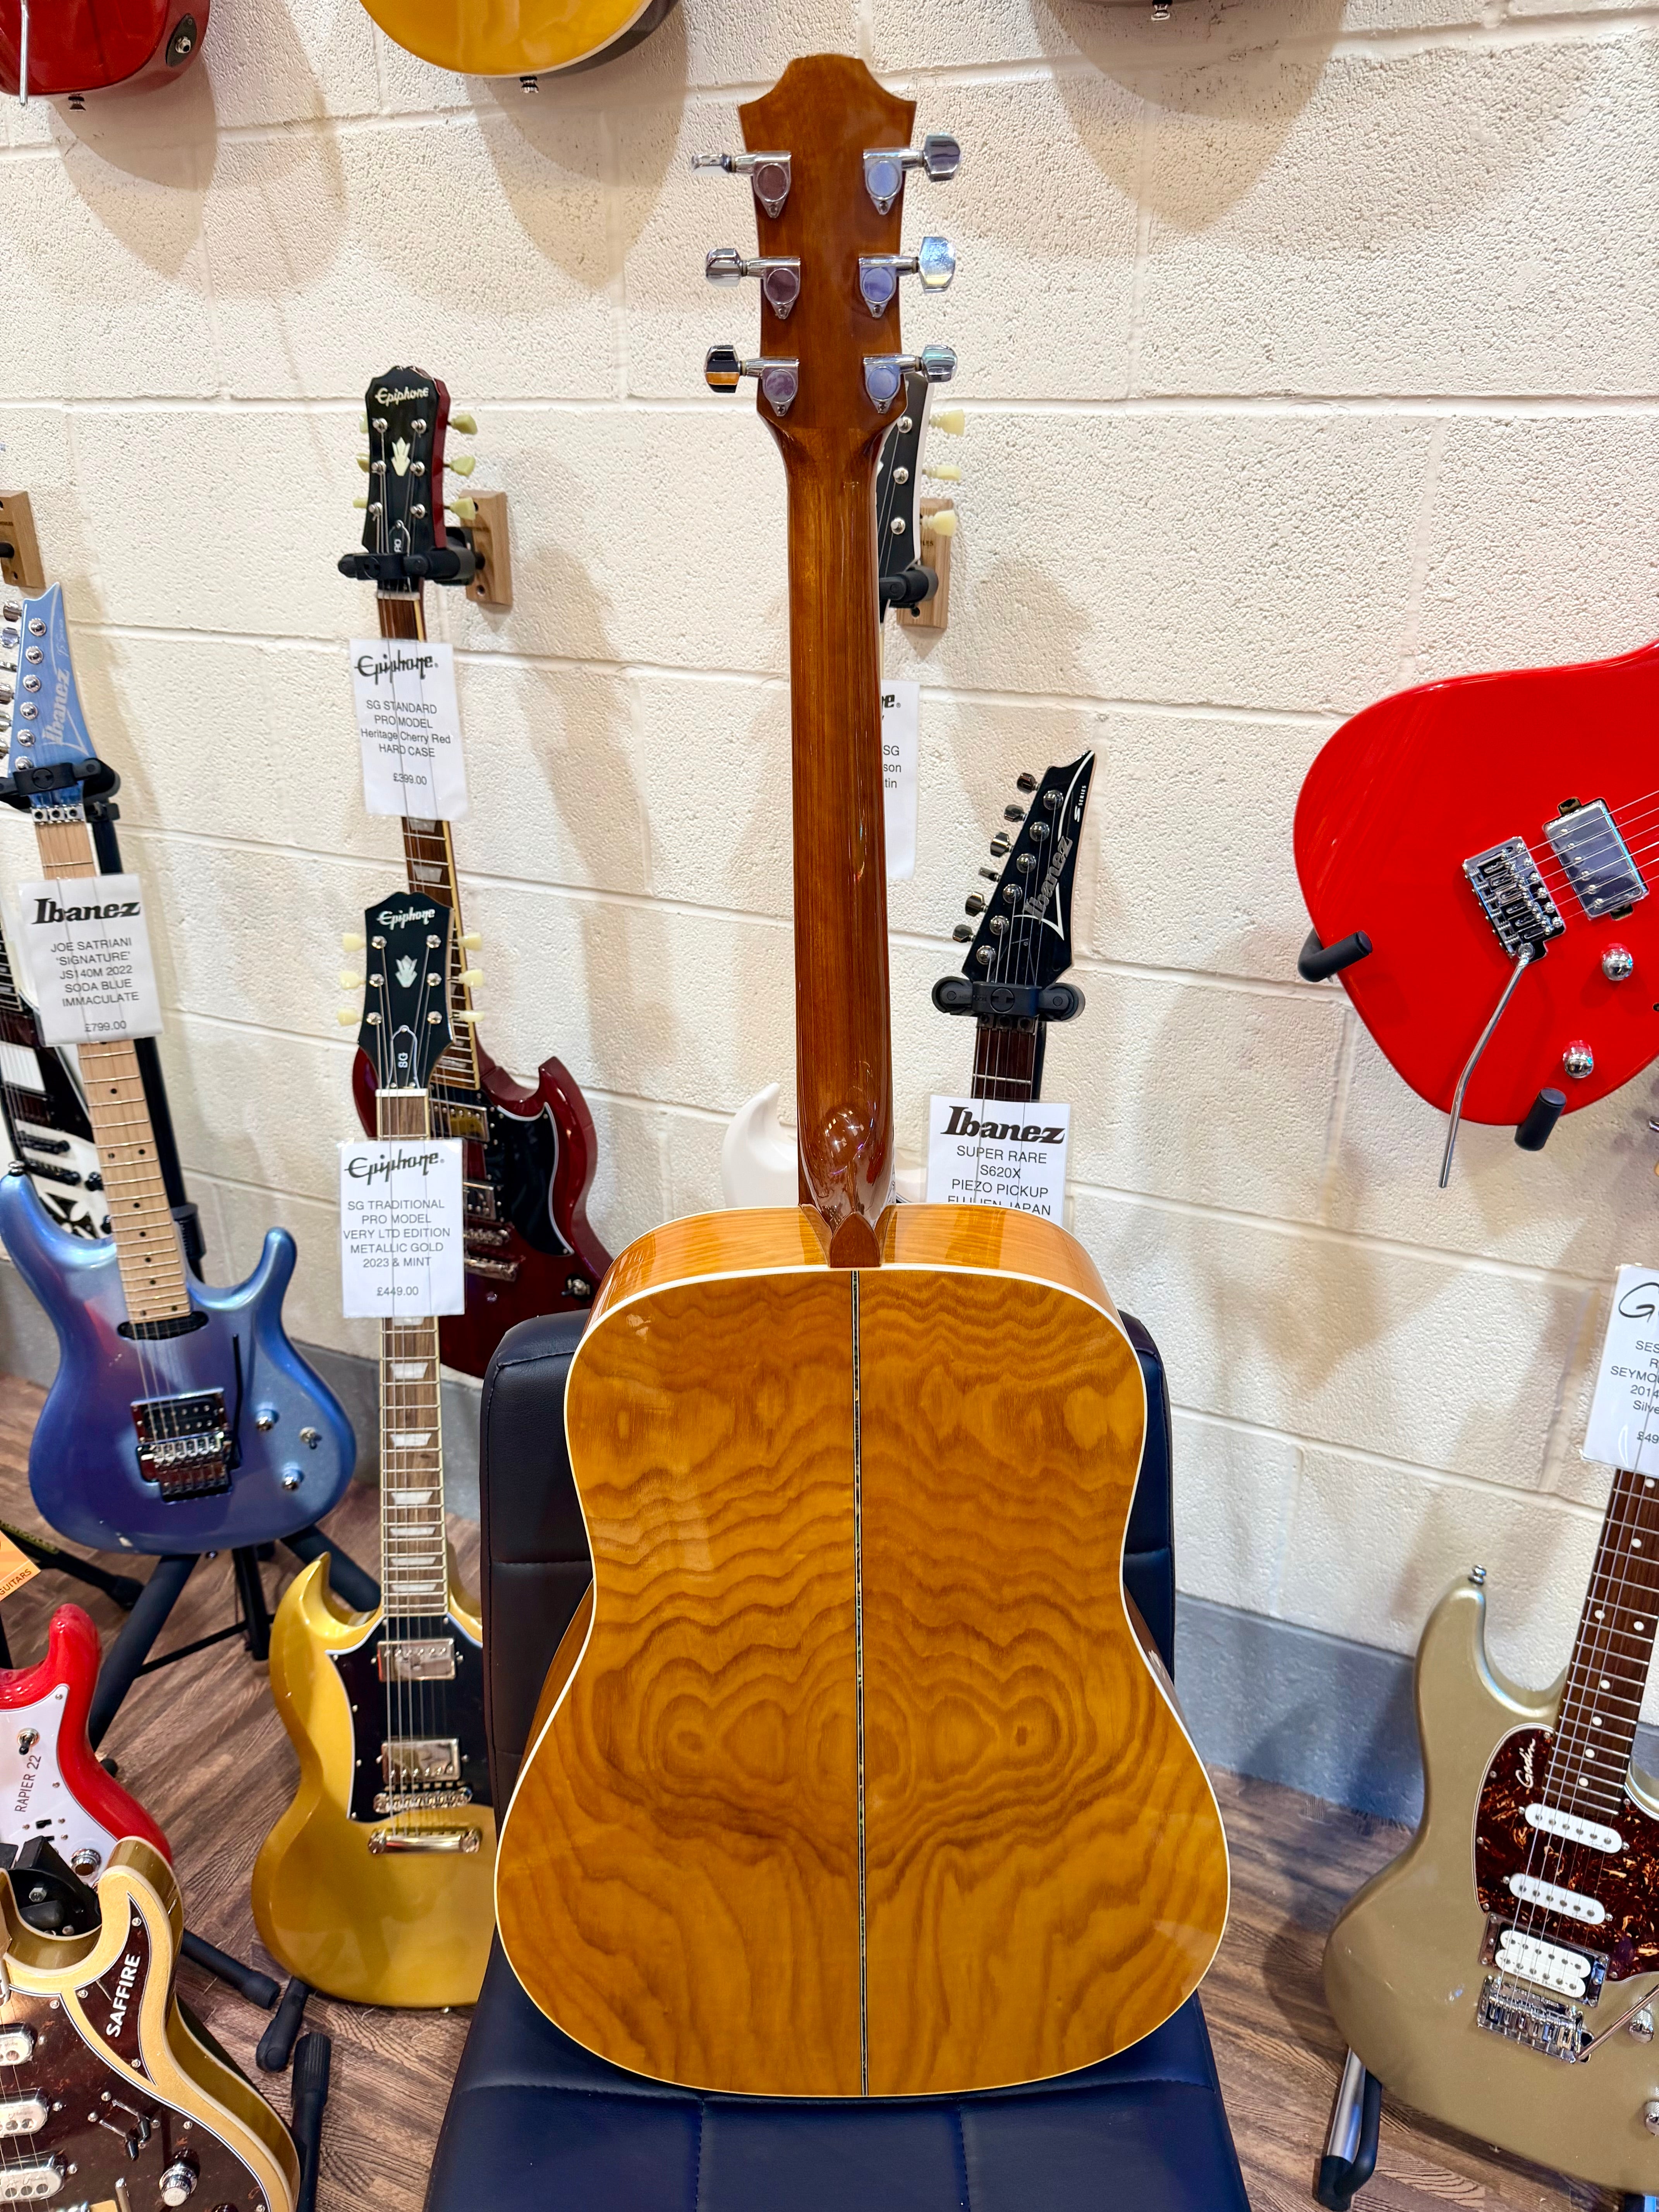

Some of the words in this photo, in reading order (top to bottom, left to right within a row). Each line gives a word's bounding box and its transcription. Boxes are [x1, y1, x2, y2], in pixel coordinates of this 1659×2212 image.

[375, 386, 429, 406] Epiphone
[354, 649, 433, 685] Epiphone
[42, 669, 70, 745] Ibanez
[366, 700, 381, 710] SG
[383, 701, 437, 714] STANDARD
[374, 715, 396, 725] PRO
[398, 717, 433, 728] MODEL
[361, 728, 398, 741] Heritage
[400, 732, 429, 745] Cherry
[432, 734, 451, 744] Red
[379, 744, 406, 755] HARD
[408, 746, 435, 757] CASE
[883, 745, 899, 756] SG
[393, 773, 427, 785] £399.00
[1078, 785, 1086, 806] SERIES
[1022, 836, 1073, 925] Ibanez
[31, 897, 141, 925] Ibanez
[376, 907, 435, 930] Epiphone
[51, 942, 74, 952] JOE
[77, 938, 132, 950] SATRIANI
[60, 968, 103, 979] JS140M
[106, 965, 132, 975] 2022
[65, 982, 98, 993] SODA
[102, 979, 132, 990] BLUE
[62, 992, 139, 1006] IMMACULATE
[85, 1021, 126, 1032] £799.00
[398, 1053, 408, 1068] SG
[940, 1106, 1065, 1144] Ibanez
[957, 1146, 1003, 1161] SUPER
[1008, 1151, 1047, 1163] RARE
[344, 1149, 438, 1185] Epiphone
[980, 1164, 1021, 1179] S620X
[952, 1179, 992, 1193] PIEZO
[997, 1184, 1048, 1198] PICKUP
[348, 1201, 364, 1210] SG
[368, 1199, 445, 1210] TRADITIONAL
[362, 1215, 387, 1224] PRO
[392, 1214, 431, 1224] MODEL
[343, 1230, 374, 1239] VERY
[379, 1229, 400, 1238] LTD
[404, 1228, 450, 1238] EDITION
[350, 1243, 407, 1254] METALLIC
[411, 1242, 443, 1252] GOLD
[363, 1258, 389, 1267] 2023
[392, 1257, 399, 1267] &
[404, 1257, 432, 1267] MINT
[377, 1286, 419, 1296] £449.00
[0, 1569, 31, 1595] GUITARS
[1515, 1738, 1536, 1788] Godin
[14, 1774, 36, 1812] RAPIER
[26, 1755, 41, 1770] 22
[106, 1954, 141, 2037] SAFFIRE
